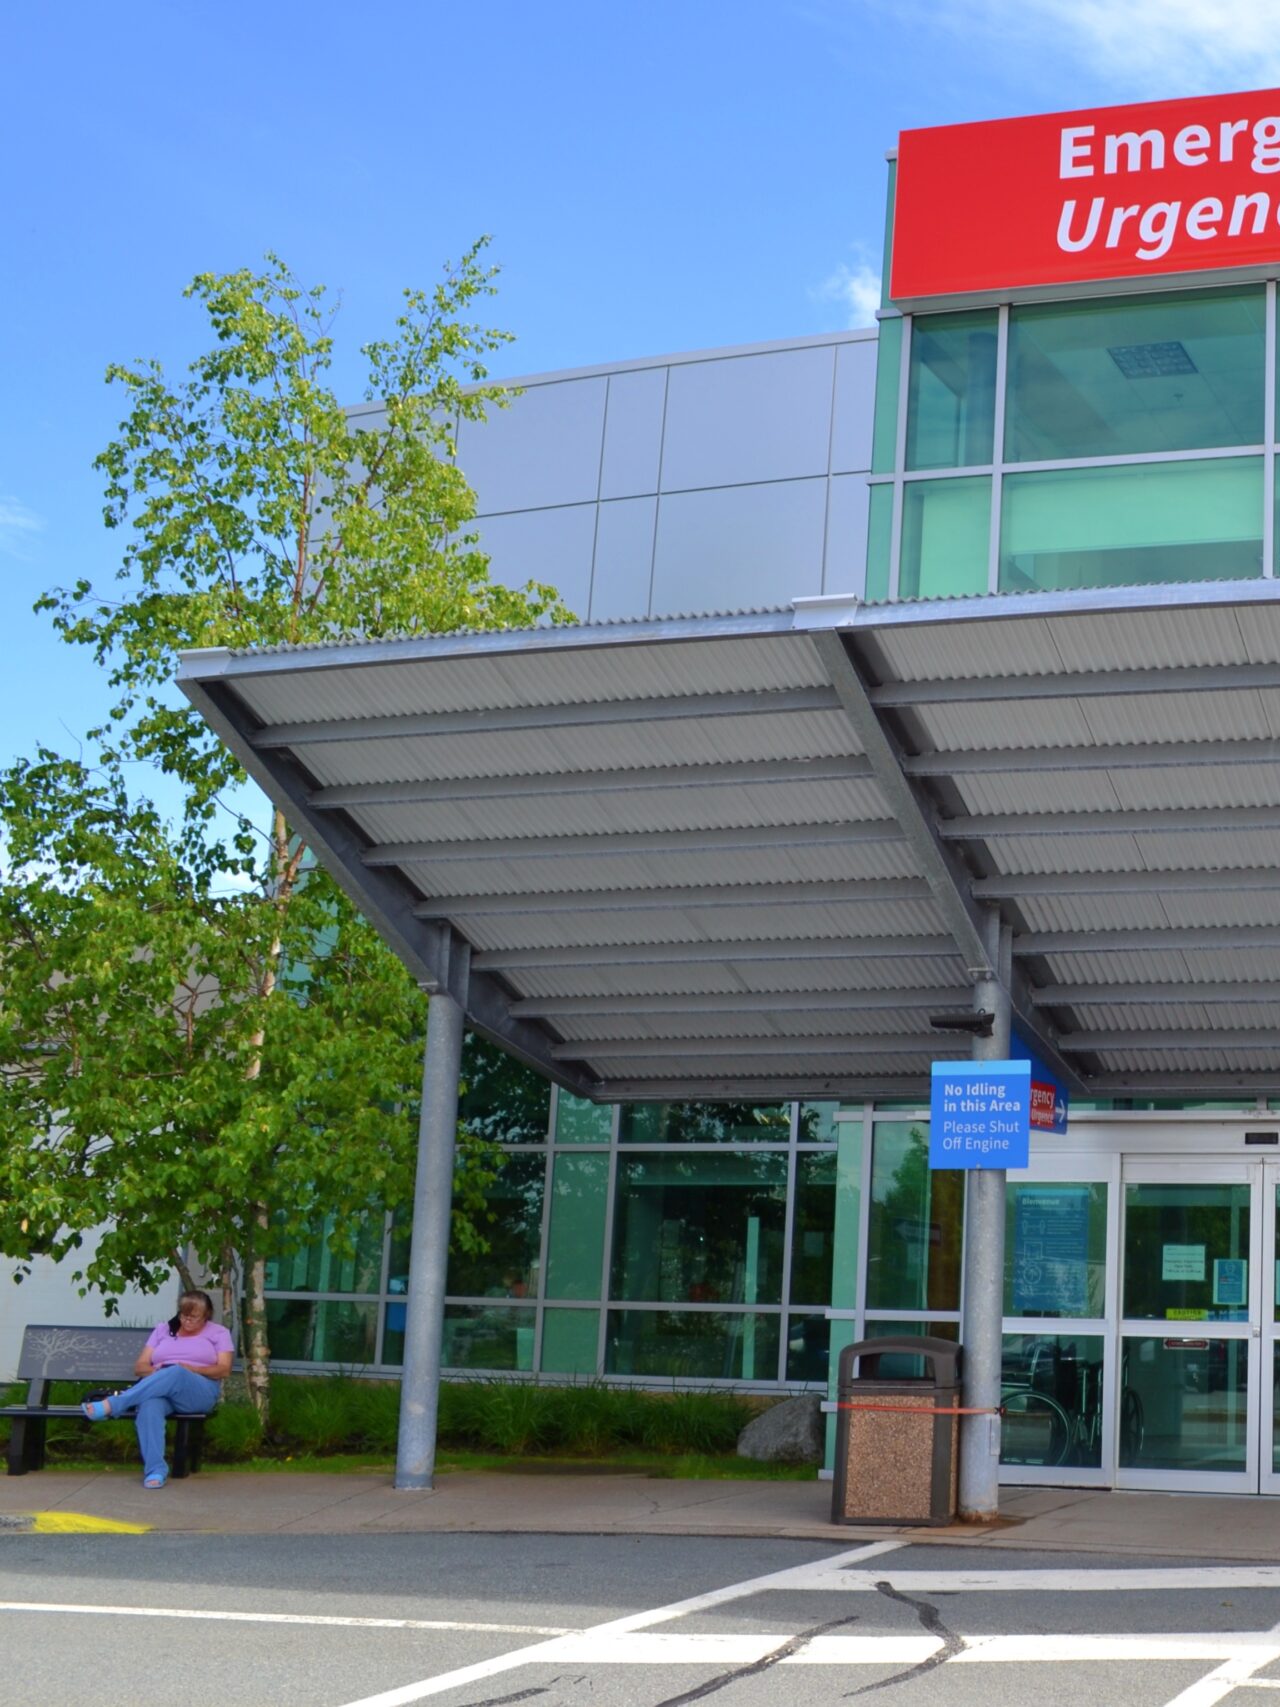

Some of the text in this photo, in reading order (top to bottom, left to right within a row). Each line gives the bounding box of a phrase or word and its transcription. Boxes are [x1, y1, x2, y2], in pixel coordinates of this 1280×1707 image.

[944, 1083, 1006, 1099] No Idling
[1030, 1088, 1055, 1109] rgency
[943, 1099, 1021, 1112] in this Area
[943, 1119, 1019, 1134] Please Shut
[942, 1136, 1010, 1153] Off Engine
